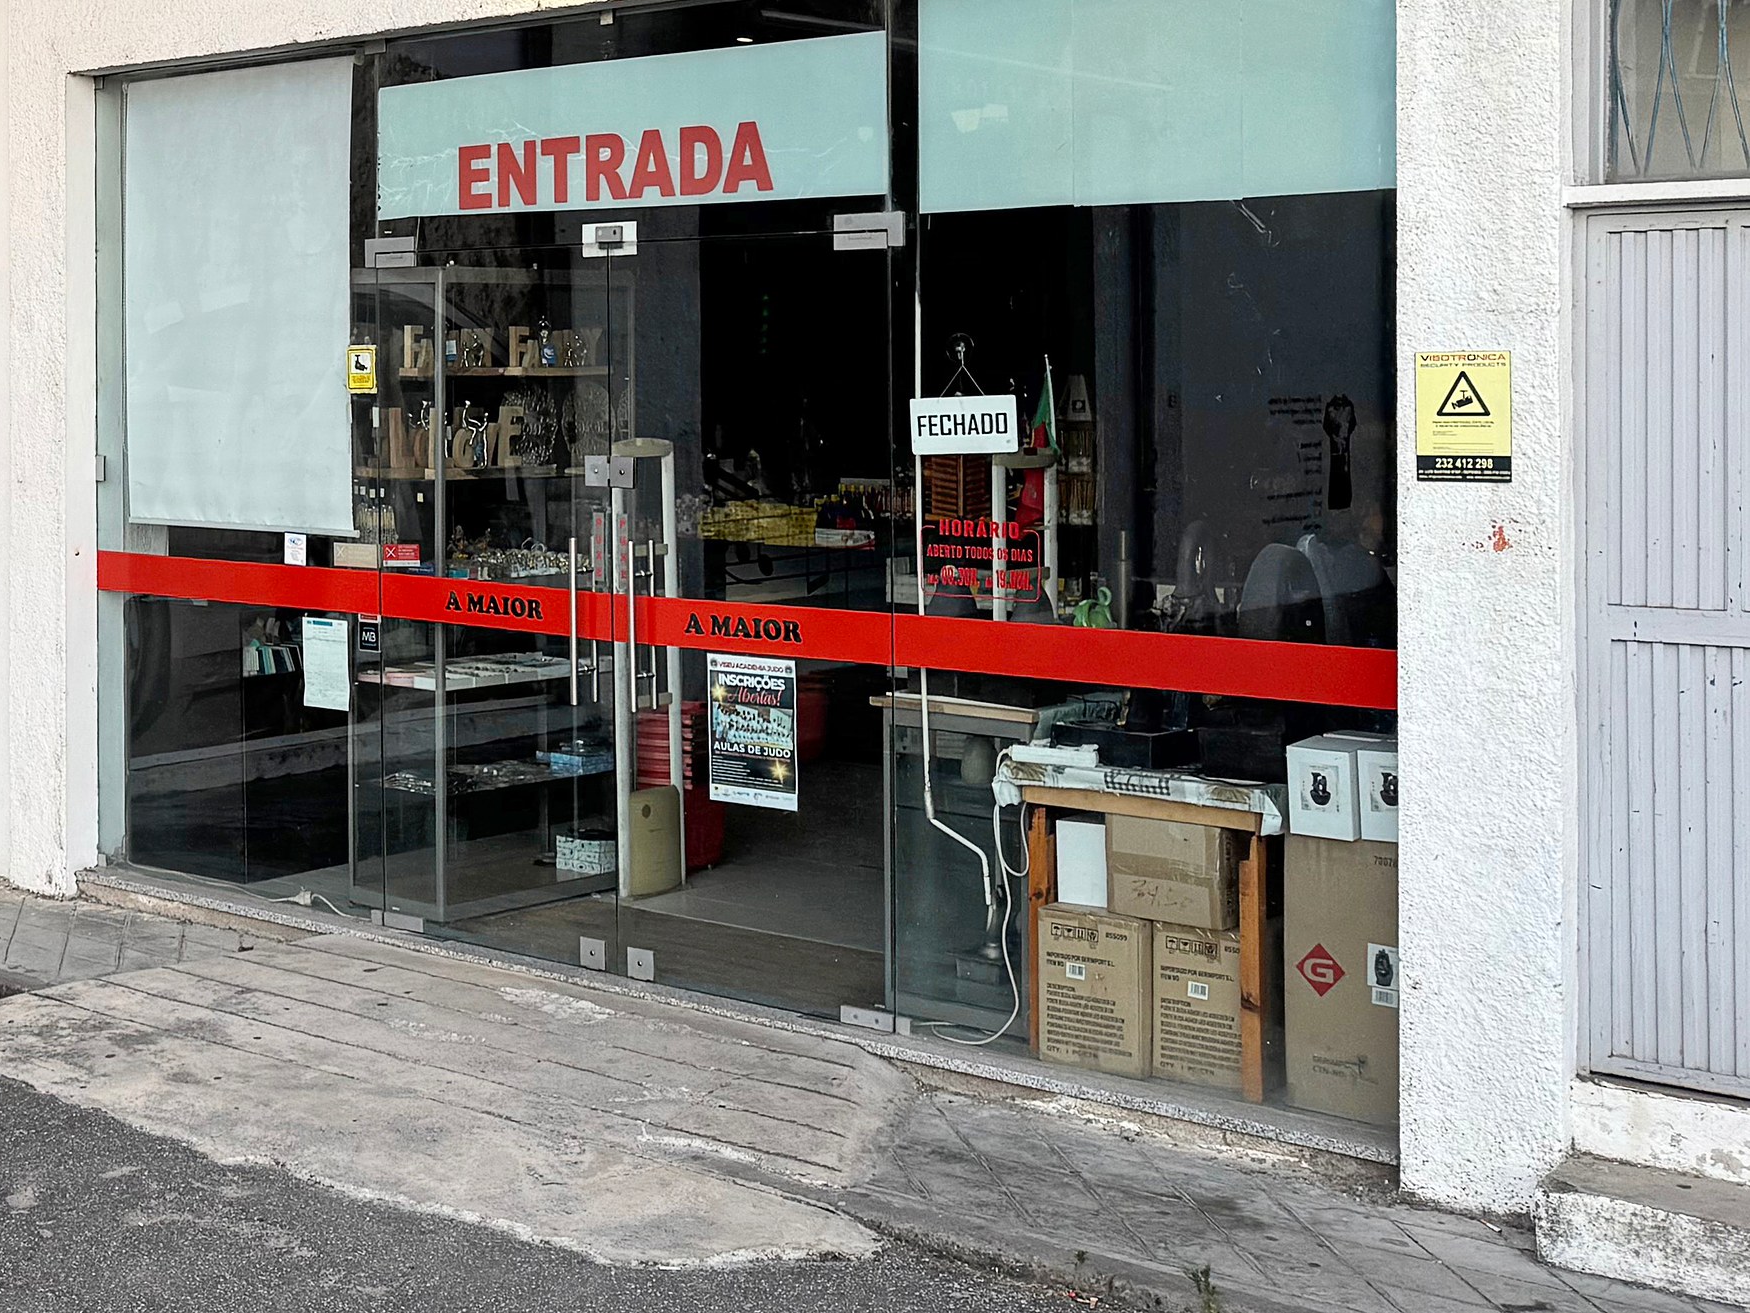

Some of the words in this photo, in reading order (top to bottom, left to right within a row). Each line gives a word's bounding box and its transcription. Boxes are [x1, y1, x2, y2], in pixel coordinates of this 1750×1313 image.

[459, 121, 774, 210] ENTRADA
[917, 412, 1008, 437] FECHADO
[1435, 457, 1453, 469] 232
[1455, 458, 1473, 469] 412
[1475, 458, 1493, 469] 298
[926, 544, 962, 559] ABERTO
[964, 546, 994, 560] TODOS
[998, 547, 1008, 561] OS
[1011, 548, 1033, 563] DIAS
[445, 591, 463, 611] A
[467, 593, 543, 621] MAIOR
[684, 613, 705, 636] A
[710, 614, 802, 644] MAIOR
[718, 673, 786, 691] INSCRIÇÕES
[727, 687, 783, 707] Abertas!
[713, 741, 745, 754] AULAS
[747, 744, 762, 756] DE
[763, 747, 791, 759] JUDO
[1303, 959, 1335, 984] G
